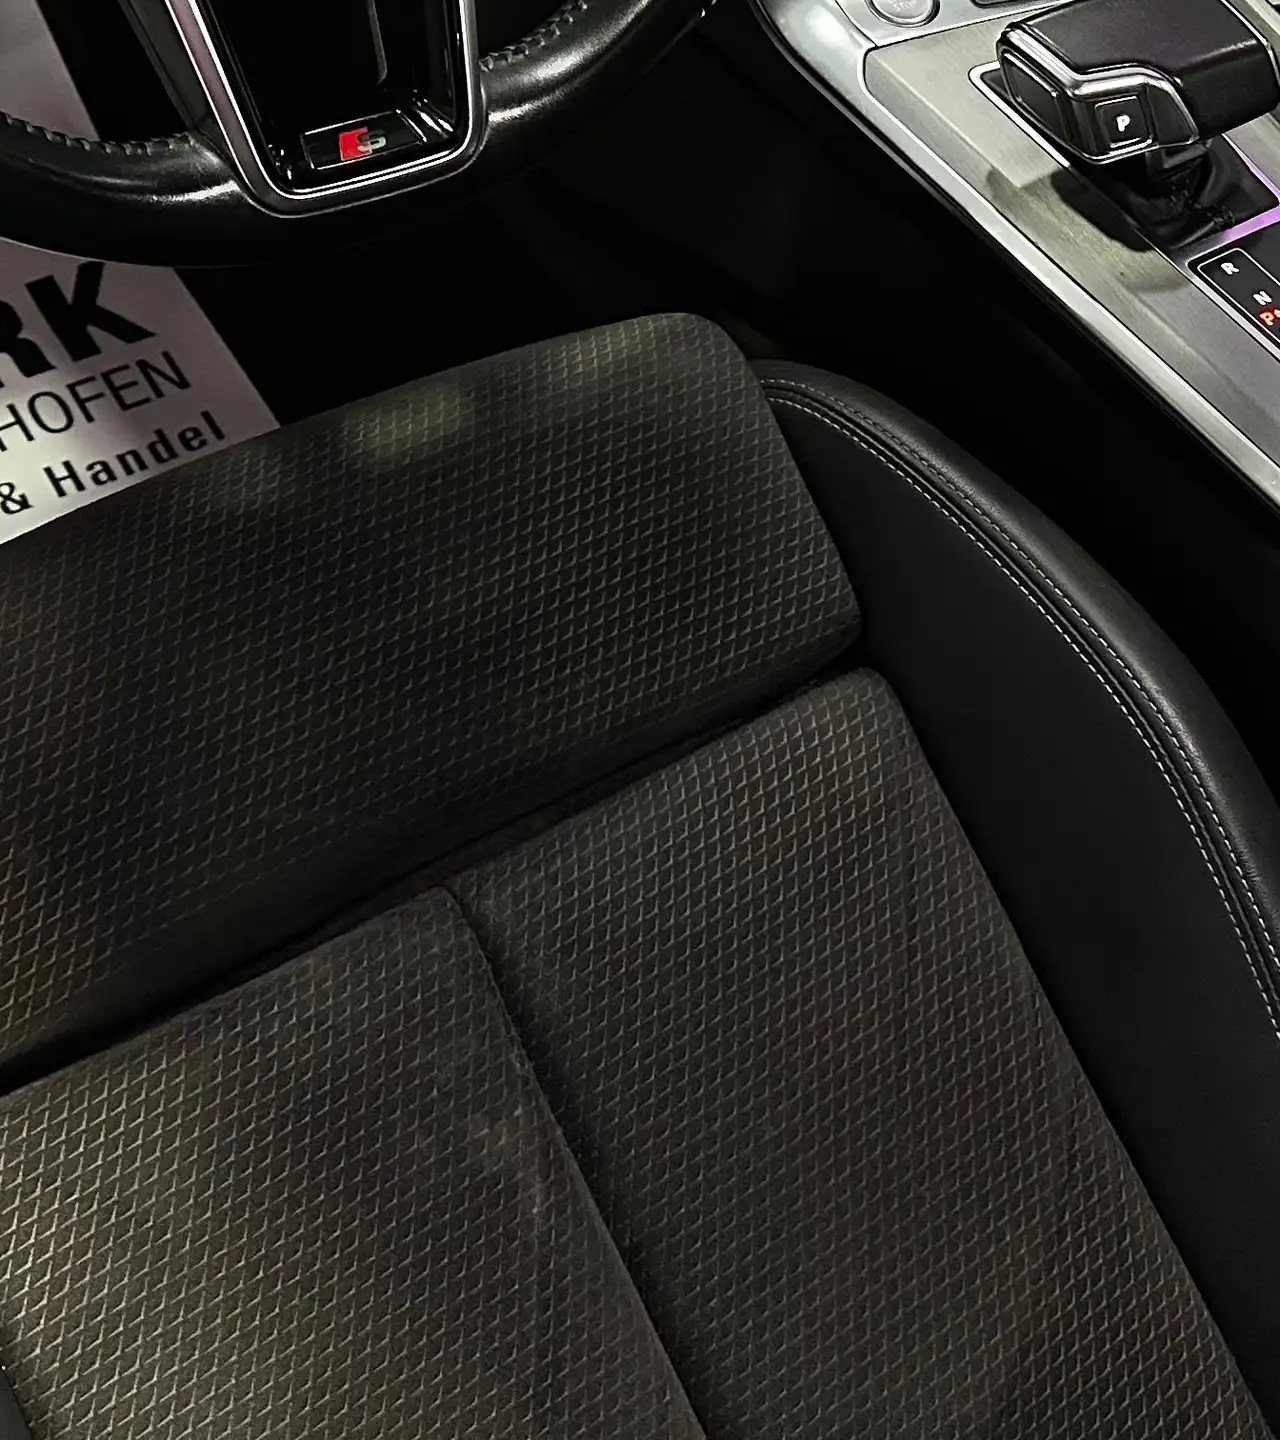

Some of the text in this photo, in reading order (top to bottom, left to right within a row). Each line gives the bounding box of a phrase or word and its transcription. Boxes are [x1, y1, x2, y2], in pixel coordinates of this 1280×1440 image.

[1116, 114, 1131, 132] P
[1220, 262, 1240, 276] R
[1252, 290, 1273, 306] N
[42, 409, 226, 498] Handel
